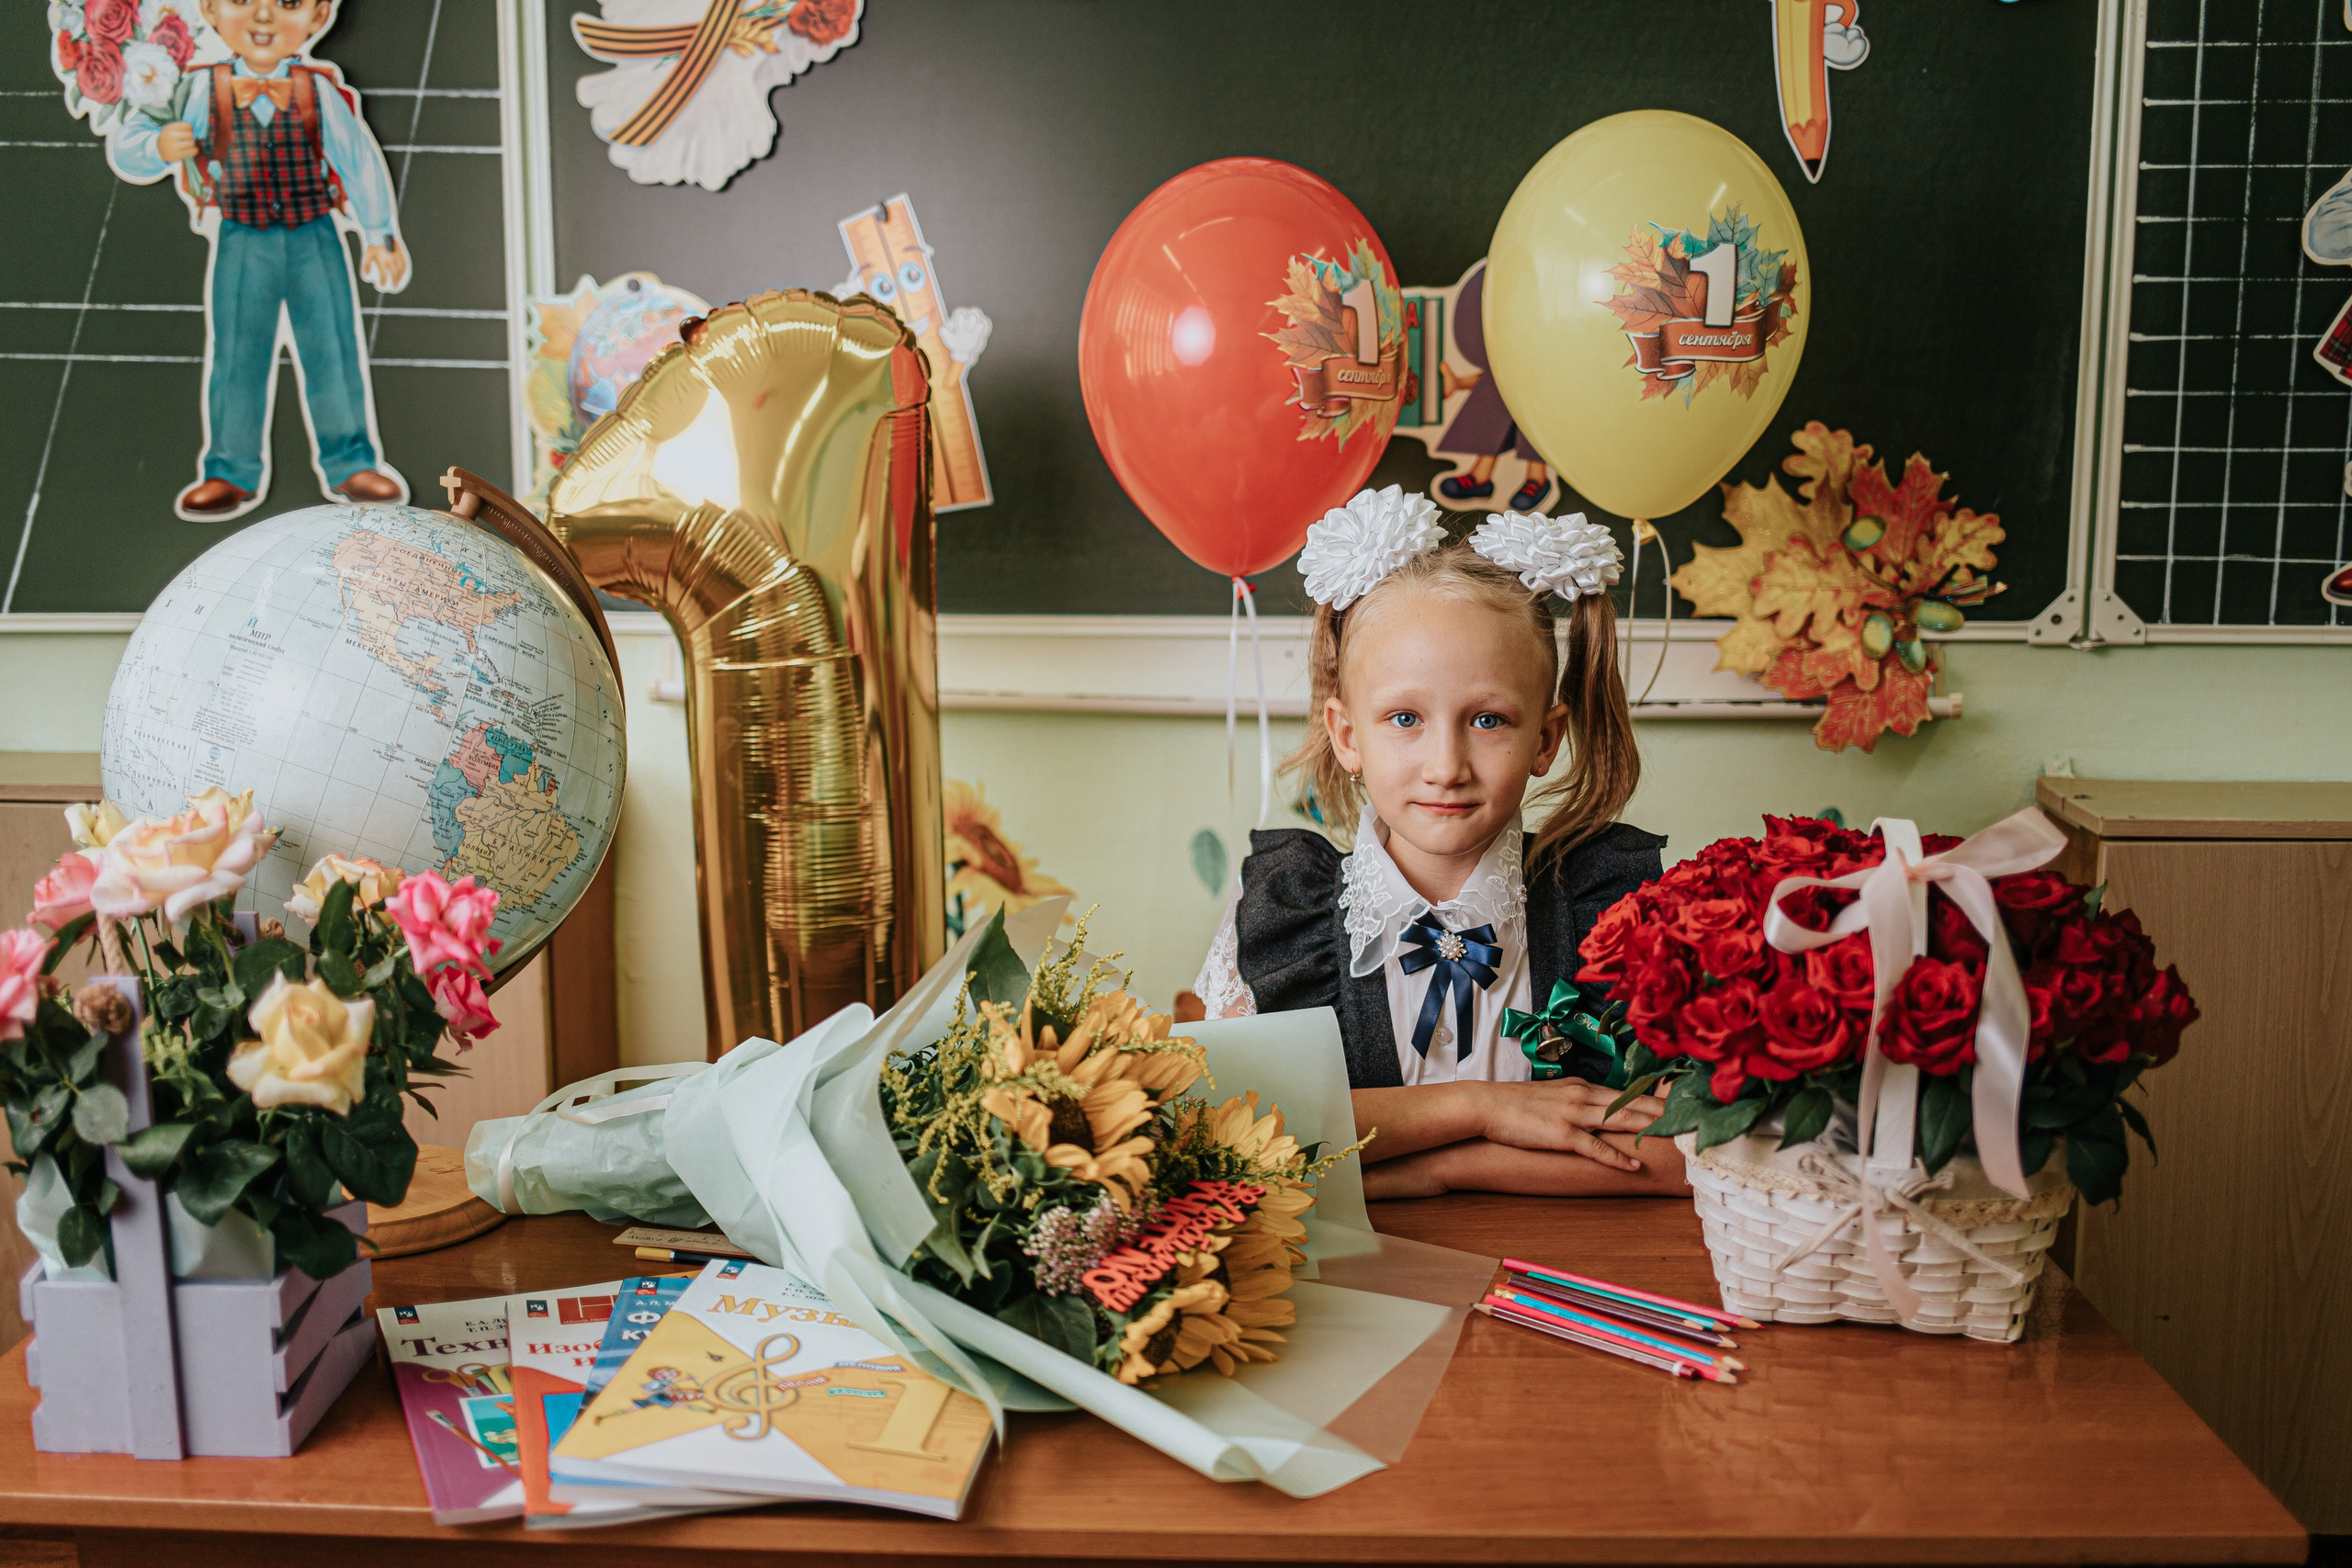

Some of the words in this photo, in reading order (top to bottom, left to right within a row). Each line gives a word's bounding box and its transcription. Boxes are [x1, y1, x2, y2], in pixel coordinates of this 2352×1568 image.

[1689, 243, 1737, 328] 1
[1340, 278, 1379, 365] 1
[1677, 331, 1754, 349] сентября
[1338, 367, 1391, 389] сентября
[372, 571, 406, 587] ШТАТЫ
[414, 587, 459, 607] АМЕРИКИ
[249, 629, 272, 641] МИР
[345, 638, 384, 658] МЕКСИКА
[522, 649, 536, 659] МОРЕ
[501, 706, 515, 716] МОРЕ
[491, 735, 526, 752] ВЕНЕСУЭЛА
[414, 757, 437, 768] ЭКВАДОР
[469, 755, 499, 770] КОЛУМБИЯ
[461, 841, 492, 857] БОЛИВИЯ
[492, 838, 551, 866] БРАЗИЛИЯ
